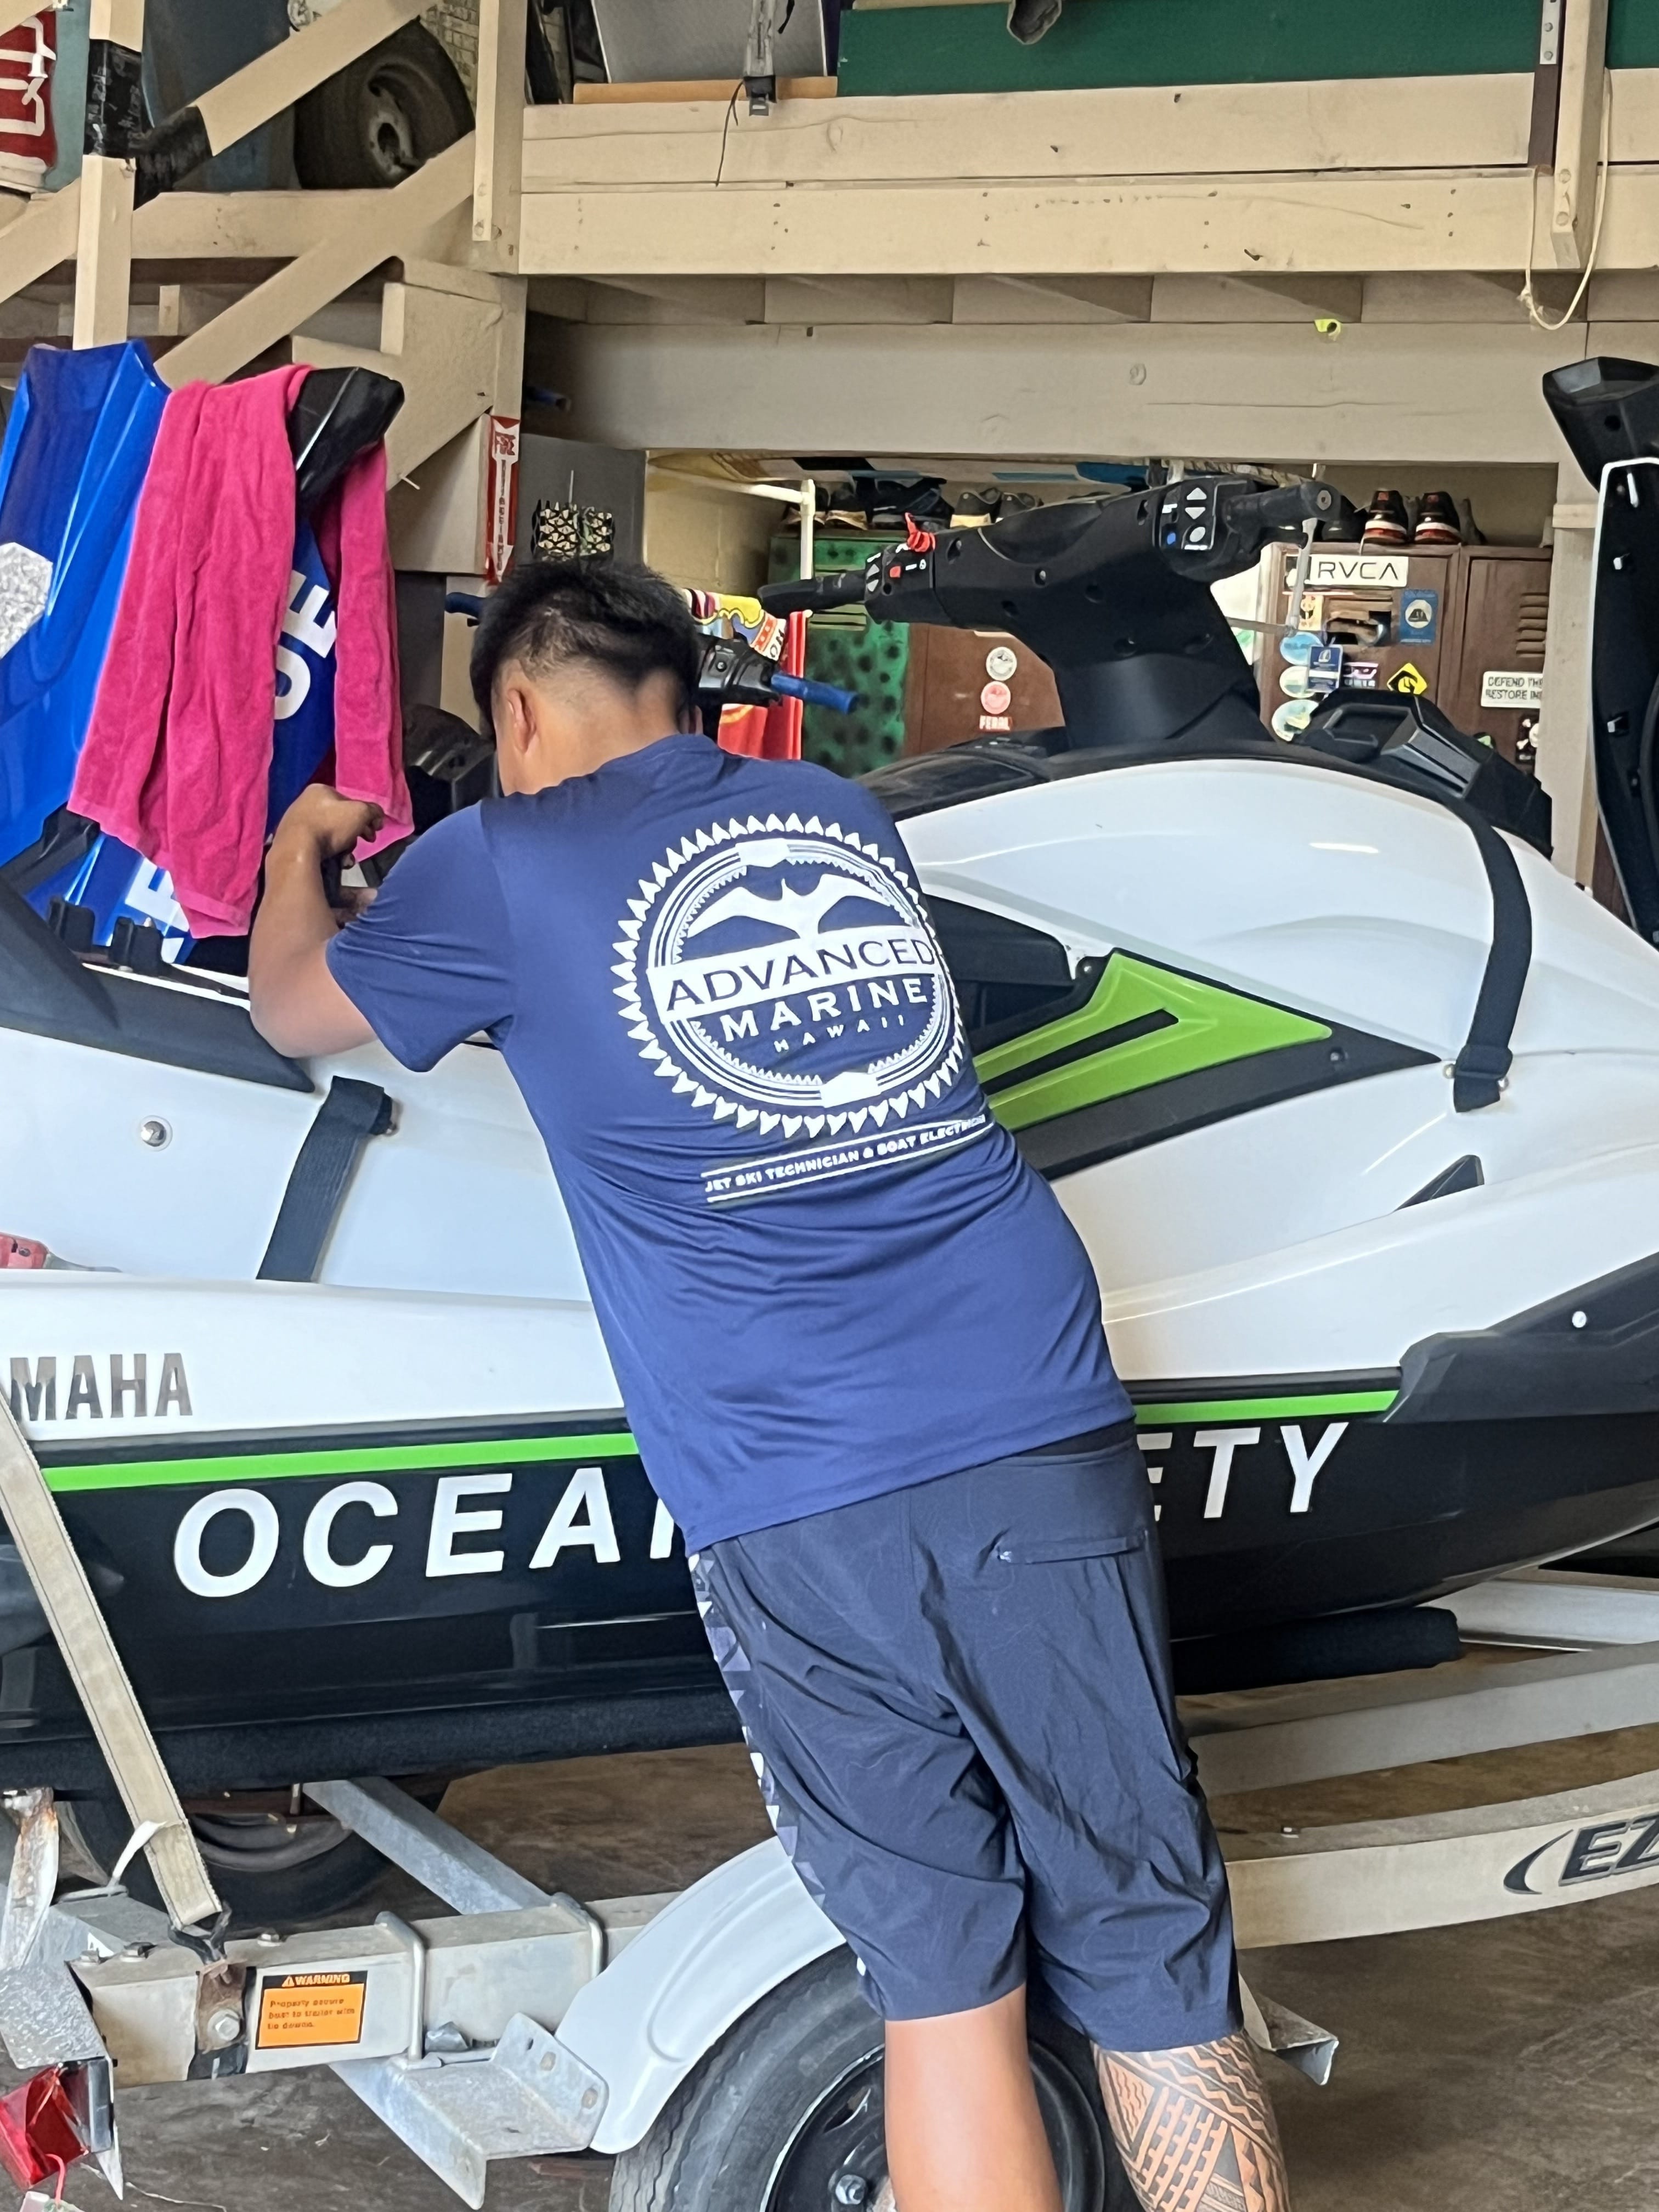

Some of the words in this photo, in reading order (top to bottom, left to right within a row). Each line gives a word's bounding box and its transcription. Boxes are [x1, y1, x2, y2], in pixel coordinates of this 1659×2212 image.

[1317, 561, 1398, 580] RVCA
[666, 938, 935, 1012] ADVANCED
[720, 978, 927, 1042] MARINE
[774, 1014, 905, 1053] HAWAII
[705, 1177, 732, 1193] JET
[735, 1171, 763, 1186] SKI
[765, 1150, 859, 1180] TECHNICIAN
[877, 1135, 916, 1155] BOAT
[10, 1352, 193, 1421] MAHA
[173, 1468, 675, 1598] OCEA
[295, 1973, 351, 1986] WARNING
